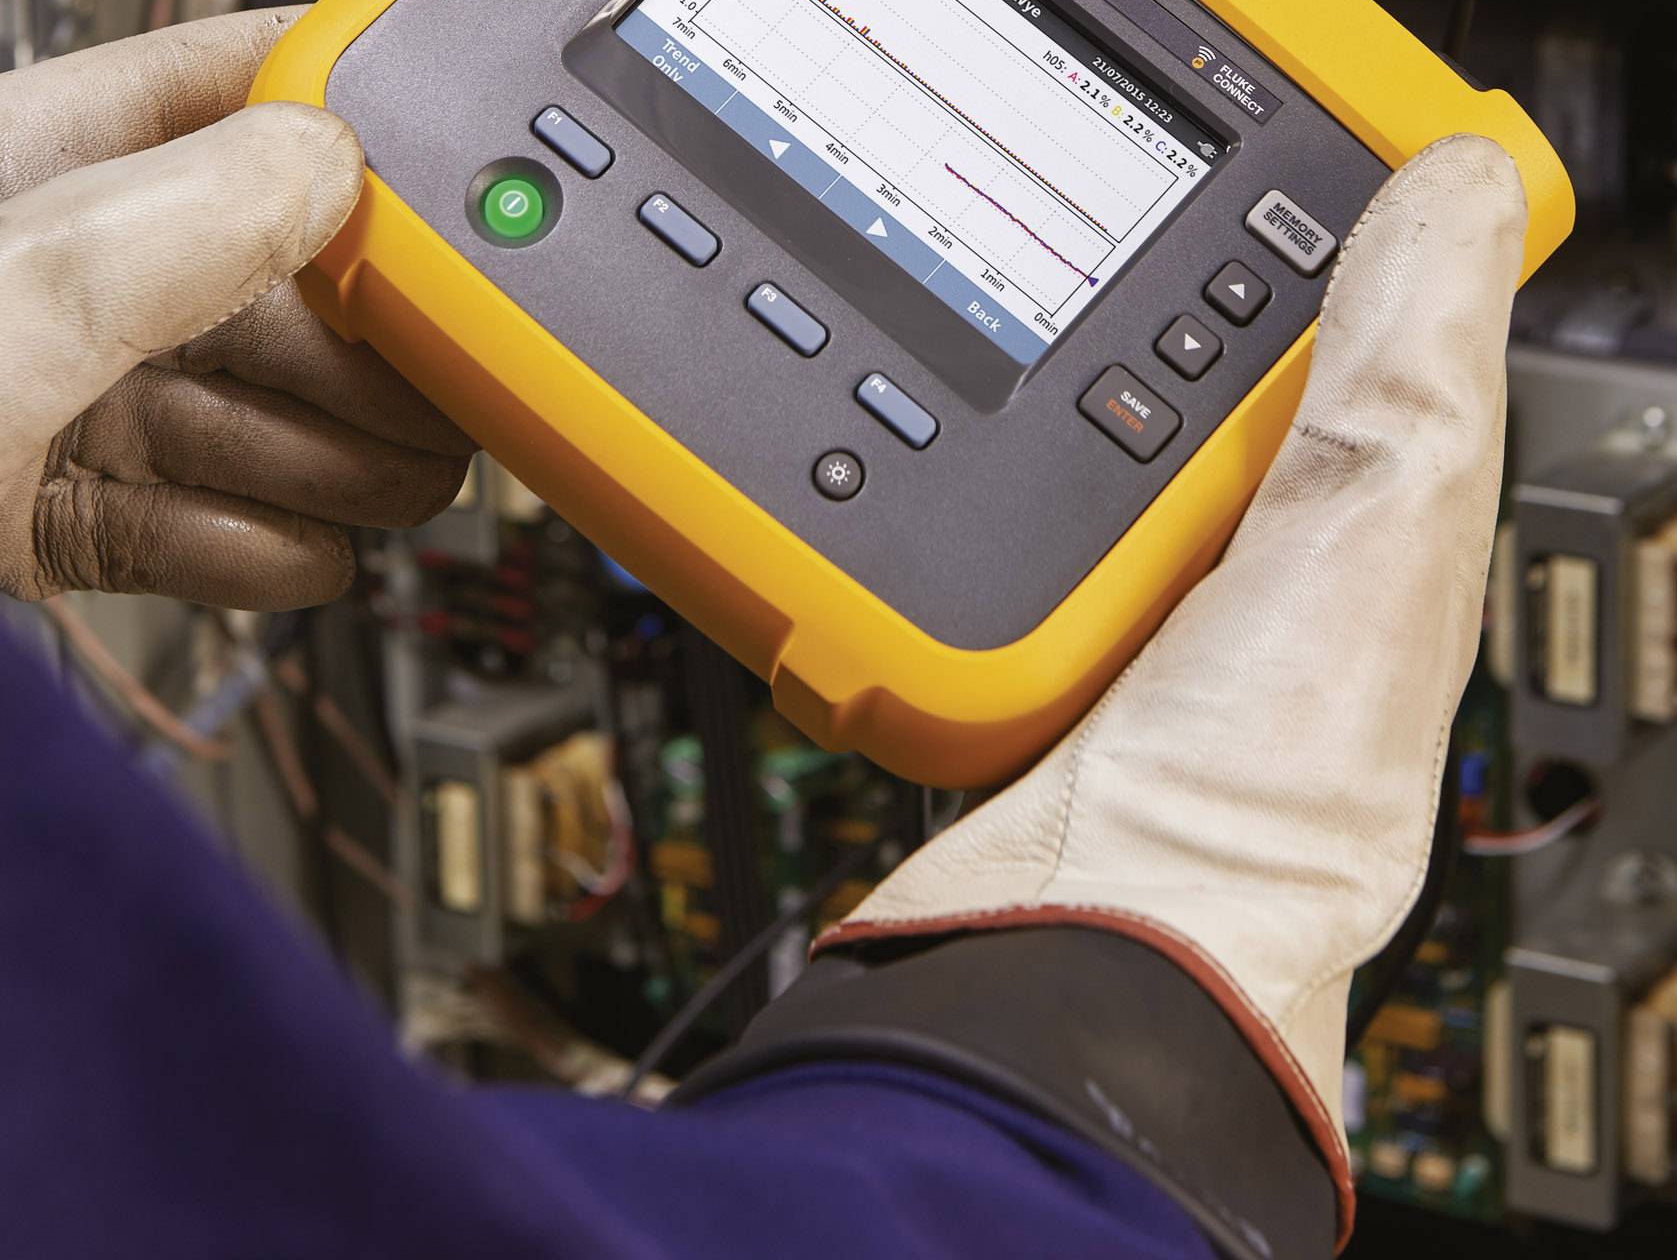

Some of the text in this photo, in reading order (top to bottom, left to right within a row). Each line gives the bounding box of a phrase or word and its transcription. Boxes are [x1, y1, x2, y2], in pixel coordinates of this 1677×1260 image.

[672, 17, 696, 39] 7min
[662, 38, 699, 73] Trend
[652, 55, 684, 82] Only
[722, 59, 747, 81] 6min
[1220, 64, 1256, 95] FLUKE
[1092, 57, 1173, 123] 21/07/2015 12:23
[1213, 73, 1264, 116] CONNECT
[547, 112, 562, 125] F1
[773, 100, 798, 123] 5min
[1043, 50, 1067, 73] h05:
[1067, 72, 1081, 84] A:
[1080, 80, 1100, 100] 2.1
[1100, 95, 1111, 108] %
[1123, 115, 1144, 134] 2.2
[1143, 129, 1155, 143] %
[1155, 141, 1167, 154] C:
[1166, 149, 1187, 168] 2.2
[1187, 164, 1198, 178] %
[825, 142, 849, 165] 4min
[653, 198, 669, 213] F2
[876, 183, 901, 207] 3min
[1263, 212, 1315, 255] SETTINGS
[1273, 202, 1323, 244] MEMORY
[928, 226, 953, 249] 2min
[980, 269, 1005, 292] 1min
[761, 288, 777, 303] F3
[967, 301, 1002, 333] Back
[1034, 312, 1059, 336] 0min
[871, 378, 887, 394] F4
[1106, 399, 1143, 433] ENTER
[1120, 391, 1151, 419] SAVE
